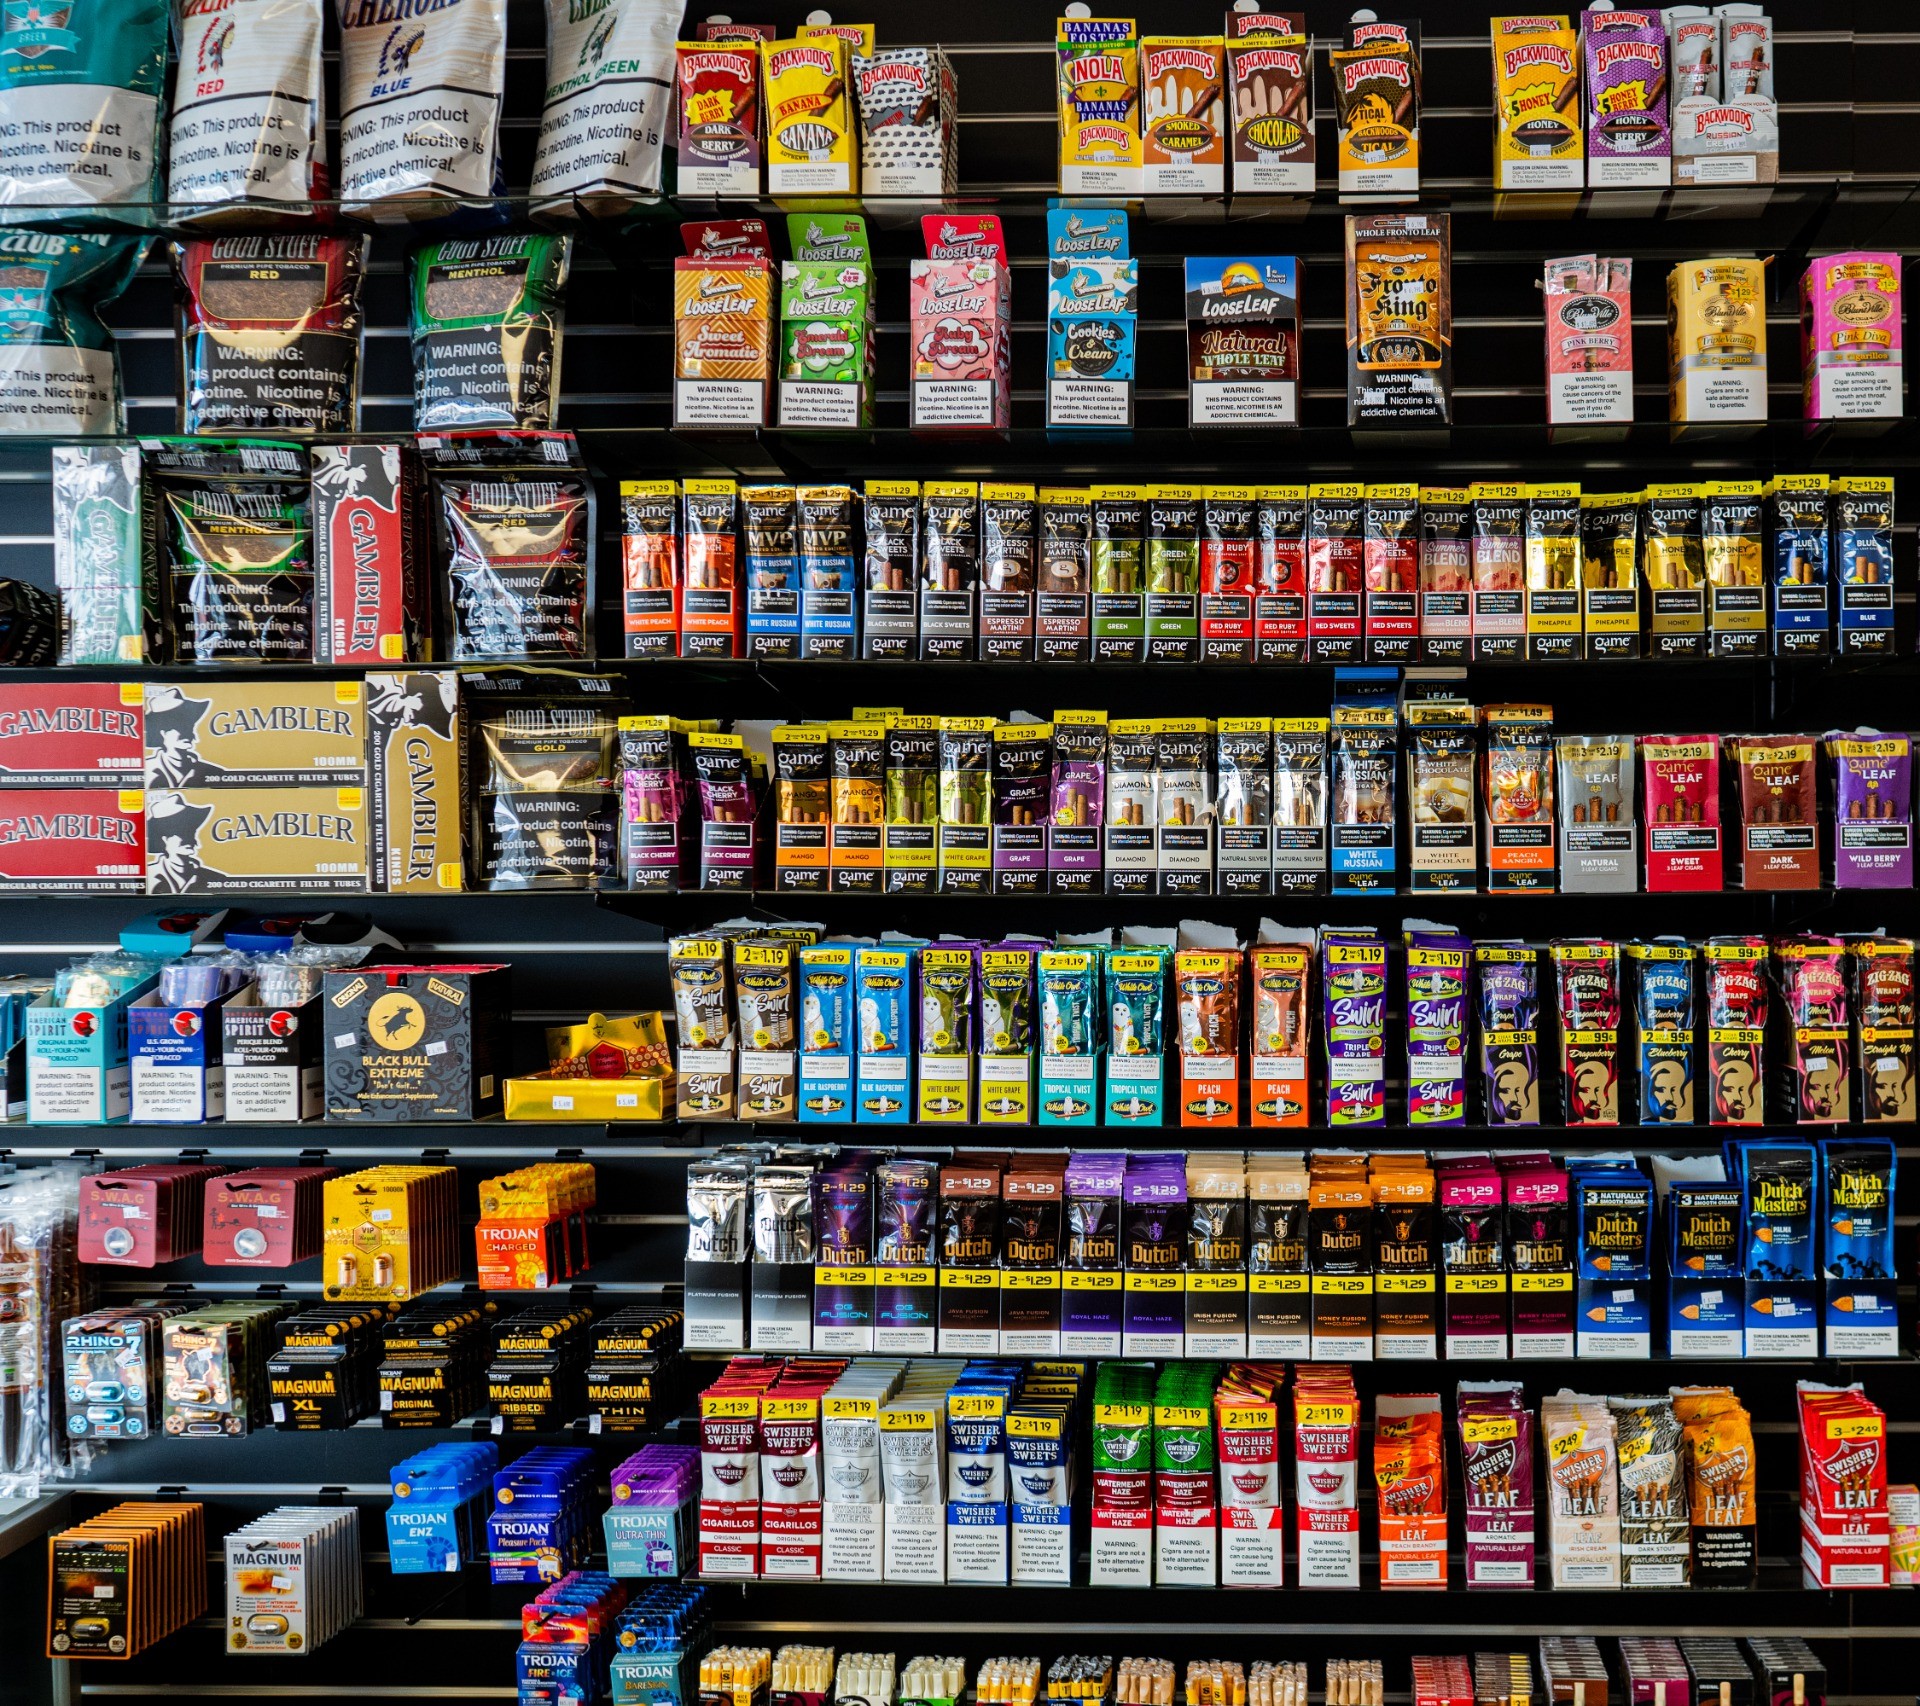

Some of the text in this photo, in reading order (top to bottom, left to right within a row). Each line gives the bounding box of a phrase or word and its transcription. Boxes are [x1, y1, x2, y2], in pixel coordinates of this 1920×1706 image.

[1505, 44, 1572, 77] BACKWOODS
[595, 59, 640, 80] GREEN
[684, 53, 751, 83] BACKWOODS
[1076, 59, 1121, 80] NOLA
[1345, 59, 1408, 91] BACKWOODS
[196, 78, 224, 97] RED
[370, 77, 412, 98] BLUE
[780, 97, 820, 115] BANANA
[1076, 102, 1127, 112] BANANAS
[1166, 122, 1200, 130] SMOKED
[1696, 109, 1753, 135] BACKWOODS
[587, 123, 658, 145] Nicotine is
[780, 124, 833, 149] BANANA
[1248, 120, 1301, 144] CHOCOLATE
[1162, 137, 1203, 146] CARAMEL
[1362, 142, 1395, 150] TICAL
[573, 151, 629, 171] chemical.
[1356, 228, 1441, 237] WHOLE FRONTO LEAF
[250, 270, 280, 280] RED
[448, 267, 504, 278] MENTHOL
[697, 325, 744, 343] Sweet
[795, 329, 848, 343] Emerald
[1068, 323, 1115, 340] Cookies
[1836, 331, 1887, 342] Pink Diva
[1086, 339, 1095, 348] &
[1201, 331, 1287, 354] Natural
[1566, 337, 1615, 347] PINK BERRY
[218, 346, 304, 361] WARNING:
[684, 341, 759, 362] Aromatic
[1069, 345, 1114, 361] Cream
[1202, 354, 1285, 366] WHOLE LEAF
[1571, 361, 1610, 369] 25 CIGARS
[1798, 478, 1820, 488] $1.29
[804, 531, 846, 546] MVP
[349, 509, 386, 651] GAMBLER
[206, 584, 273, 595] WARNING:
[334, 618, 345, 656] KINGS
[633, 637, 667, 654] game
[209, 706, 354, 738] GAMBLER
[534, 744, 566, 752] GOLD
[1679, 747, 1702, 756] $2.19
[312, 756, 357, 767] 100MM
[1348, 851, 1378, 859] WHITE
[1344, 857, 1383, 867] RUSSIAN
[1567, 975, 1608, 990] ZIG-ZAG
[337, 981, 365, 1004] ORIGINAL
[430, 981, 462, 1002] NATURAL
[1333, 998, 1382, 1028] Swirl
[633, 1018, 652, 1029] VIP
[29, 1025, 66, 1036] SPIRIT
[1513, 1032, 1532, 1043] 99¢
[1499, 1049, 1522, 1060] Grape
[1648, 1049, 1688, 1059] Blueberry
[1723, 1047, 1750, 1059] Cherry
[362, 1056, 431, 1066] BLACK BULL
[370, 1068, 424, 1078] EXTREME
[804, 1083, 847, 1091] BLUE RASPBERRY
[1044, 1085, 1091, 1094] TROPICAL TWIST
[1198, 1084, 1221, 1094] PEACH
[1597, 1217, 1637, 1232] Dutch
[480, 1228, 535, 1241] TROJAN
[1589, 1231, 1642, 1246] Masters
[486, 1243, 536, 1251] CHARGED
[66, 1337, 141, 1354] RHINO 7
[272, 1380, 335, 1394] MAGNUM
[293, 1400, 322, 1411] XL
[393, 1400, 434, 1409] ORIGINAL
[598, 1407, 645, 1415] THIN
[1300, 1434, 1349, 1444] SWISHER
[391, 1514, 447, 1525] TROJAN
[702, 1519, 754, 1528] CIGARILLOS
[410, 1527, 433, 1537] ENZ
[615, 1530, 666, 1539] ULTRA THIN
[277, 1542, 301, 1550] 1000K
[498, 1537, 547, 1548] Pleasure Pack
[233, 1553, 301, 1565] MAGNUM
